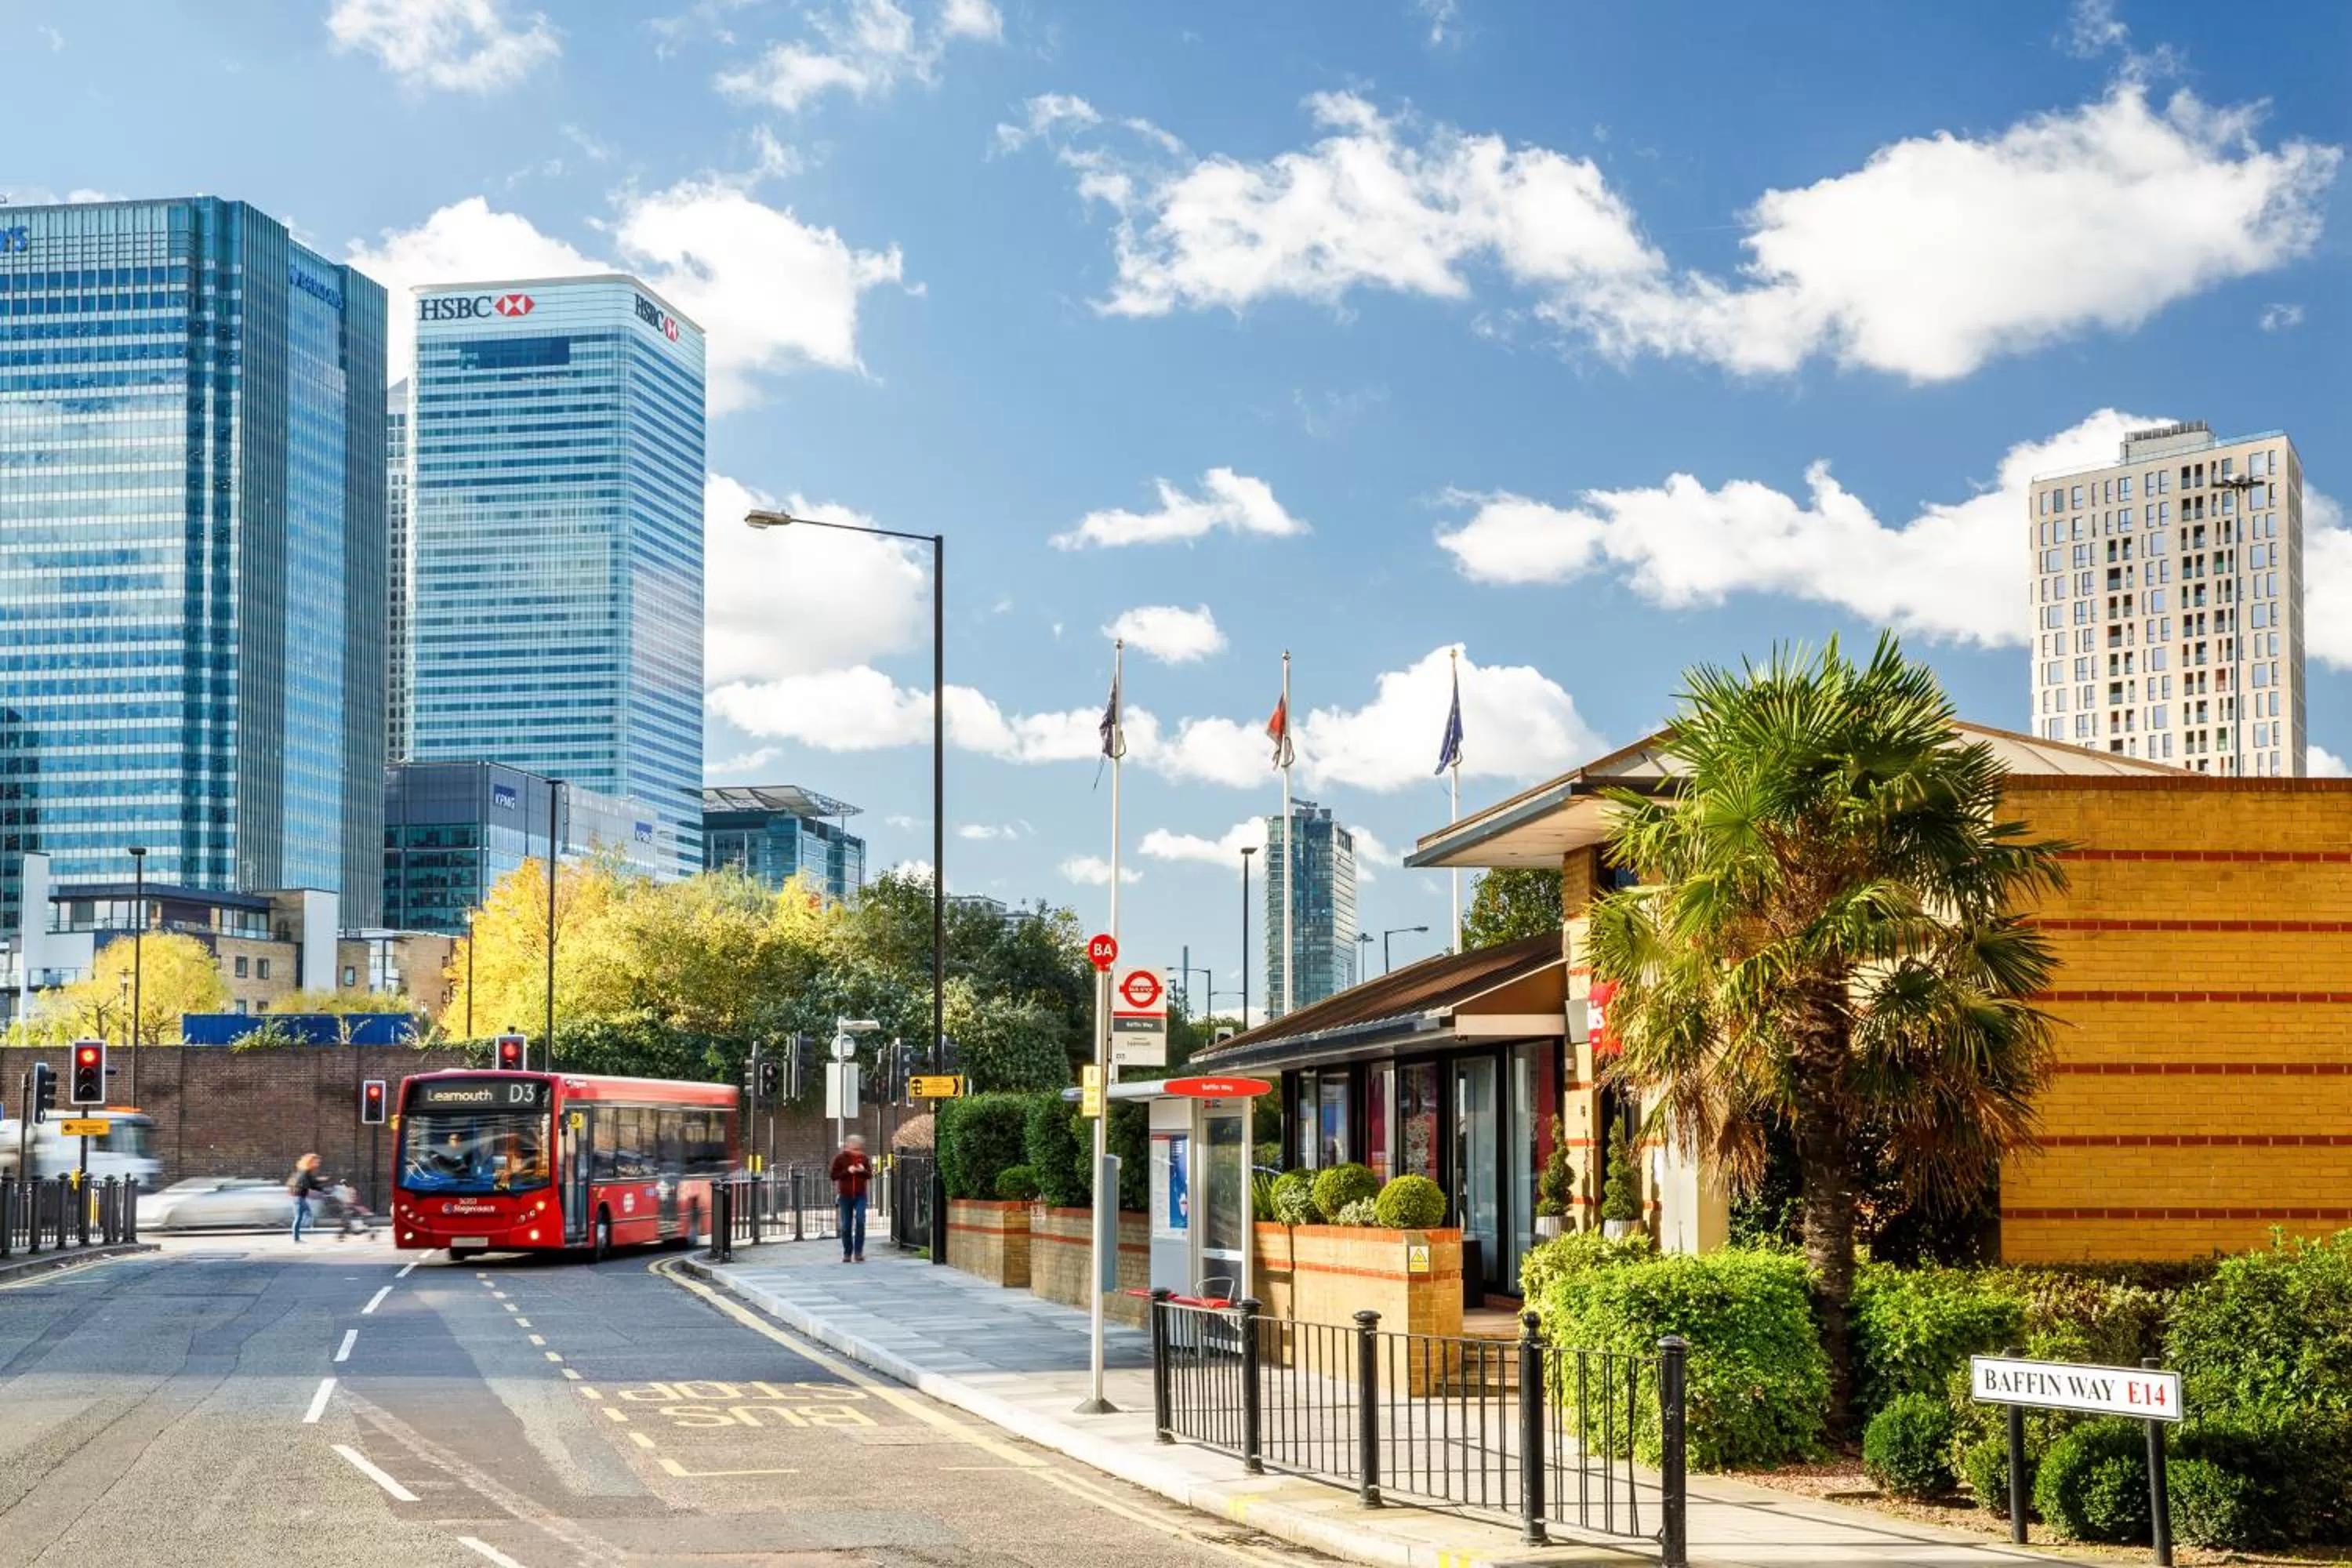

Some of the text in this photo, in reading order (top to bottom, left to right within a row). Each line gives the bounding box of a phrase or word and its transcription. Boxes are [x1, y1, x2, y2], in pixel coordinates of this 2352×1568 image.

[420, 296, 492, 321] HSBC
[635, 293, 664, 332] HSBC
[495, 793, 516, 809] KPMG
[1094, 943, 1113, 957] BA
[509, 1083, 535, 1103] D3
[453, 1204, 495, 1214] Stagecoach
[619, 1380, 869, 1402] STOP
[1984, 1368, 2165, 1406] BAFFIN WAY E14
[659, 1404, 879, 1428] BUS
